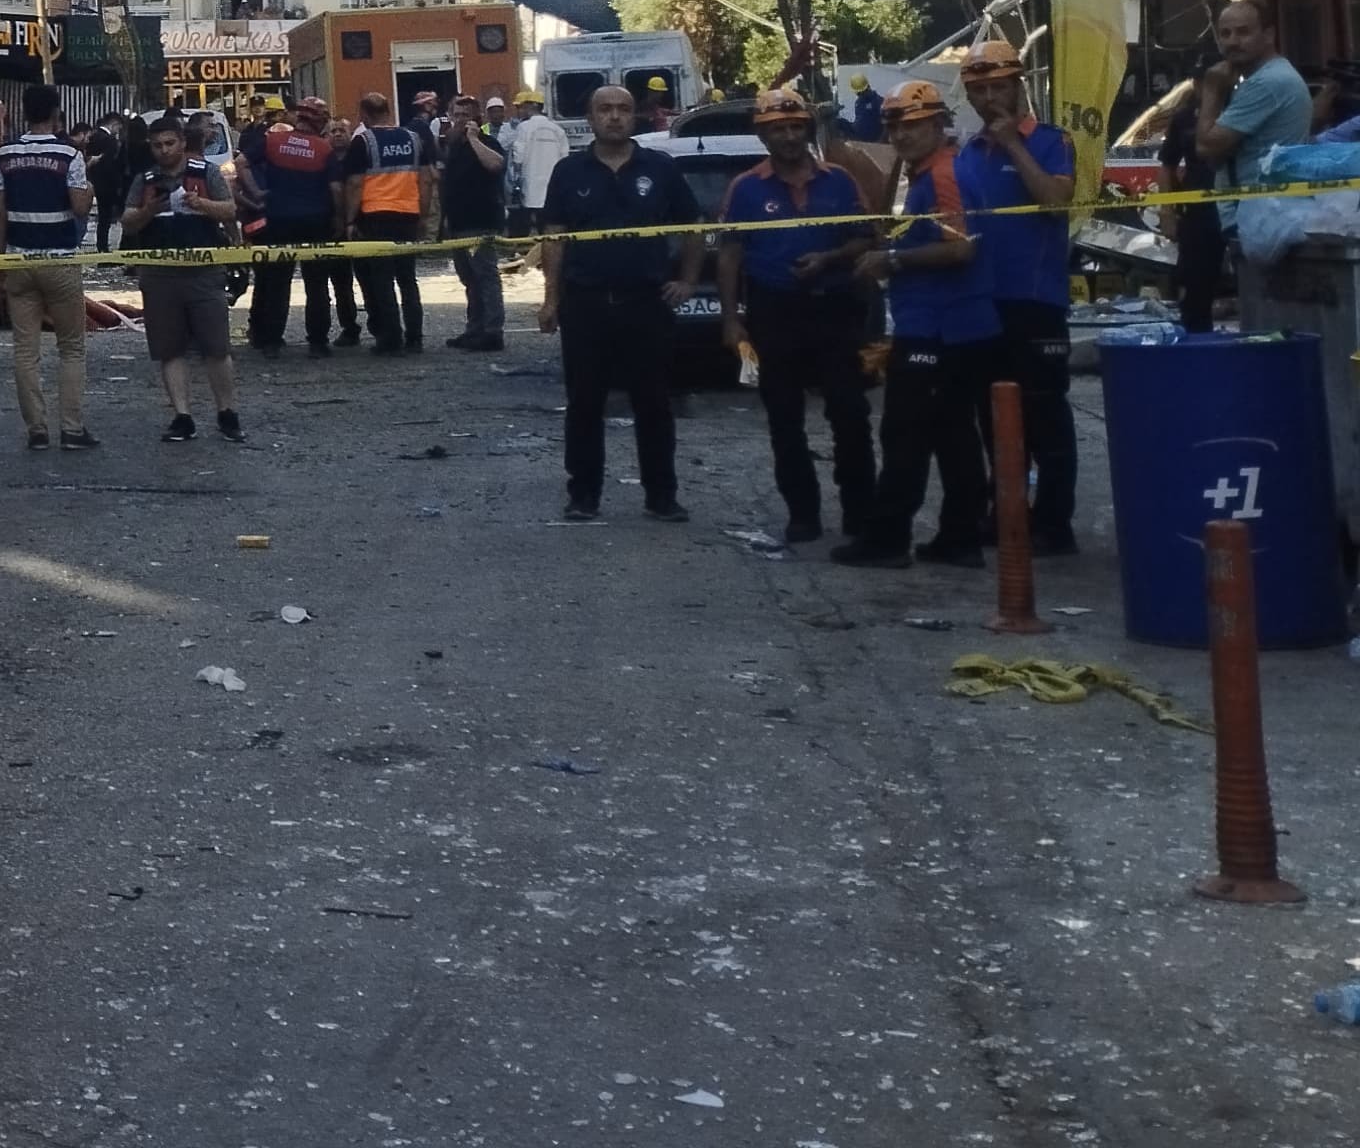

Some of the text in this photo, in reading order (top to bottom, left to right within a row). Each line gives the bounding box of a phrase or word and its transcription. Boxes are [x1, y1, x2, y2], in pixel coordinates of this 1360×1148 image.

[15, 20, 61, 56] FIRN
[164, 60, 195, 81] EK
[200, 58, 272, 81] GURME
[382, 144, 412, 157] AFAD
[909, 353, 937, 364] AFAD
[1203, 467, 1263, 519] +1
